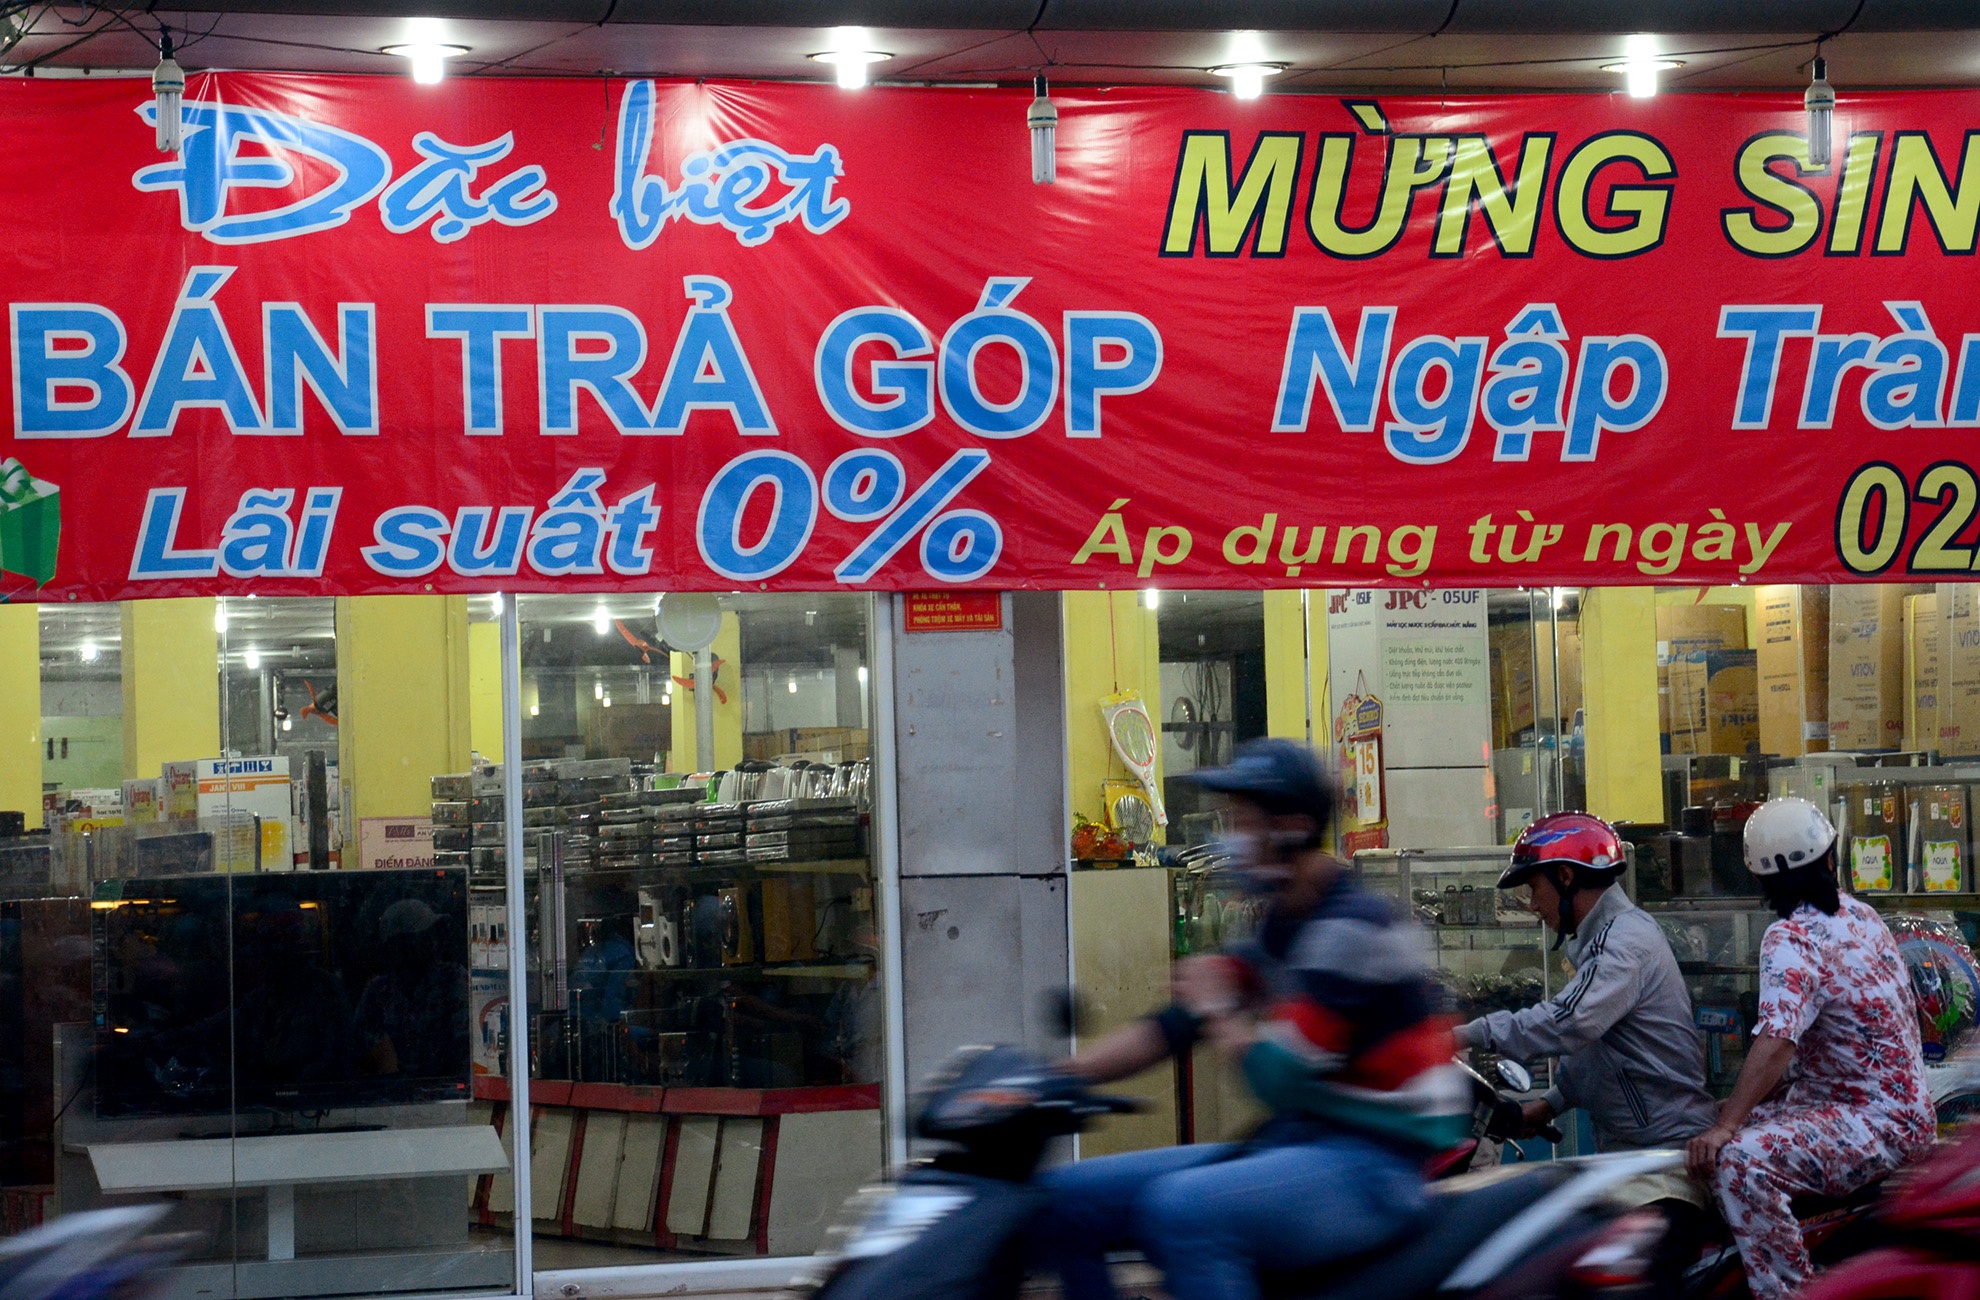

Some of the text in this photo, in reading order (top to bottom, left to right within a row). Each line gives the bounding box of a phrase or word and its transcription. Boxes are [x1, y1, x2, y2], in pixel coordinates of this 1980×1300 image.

[132, 79, 850, 250] Đặc biệt
[1158, 98, 1980, 259] MỪNG SIN
[9, 265, 1164, 440] BÁN TRẢ GÓP
[1271, 302, 1669, 465] Ngập
[128, 448, 1004, 584] Lãi suất 0%
[1071, 498, 1794, 578] Áp dụng từ ngày
[1835, 458, 1980, 575] 02
[1384, 590, 1428, 610] JPC
[1442, 590, 1480, 604] 05UF
[1959, 629, 1980, 648] QUA
[1359, 742, 1375, 775] 15
